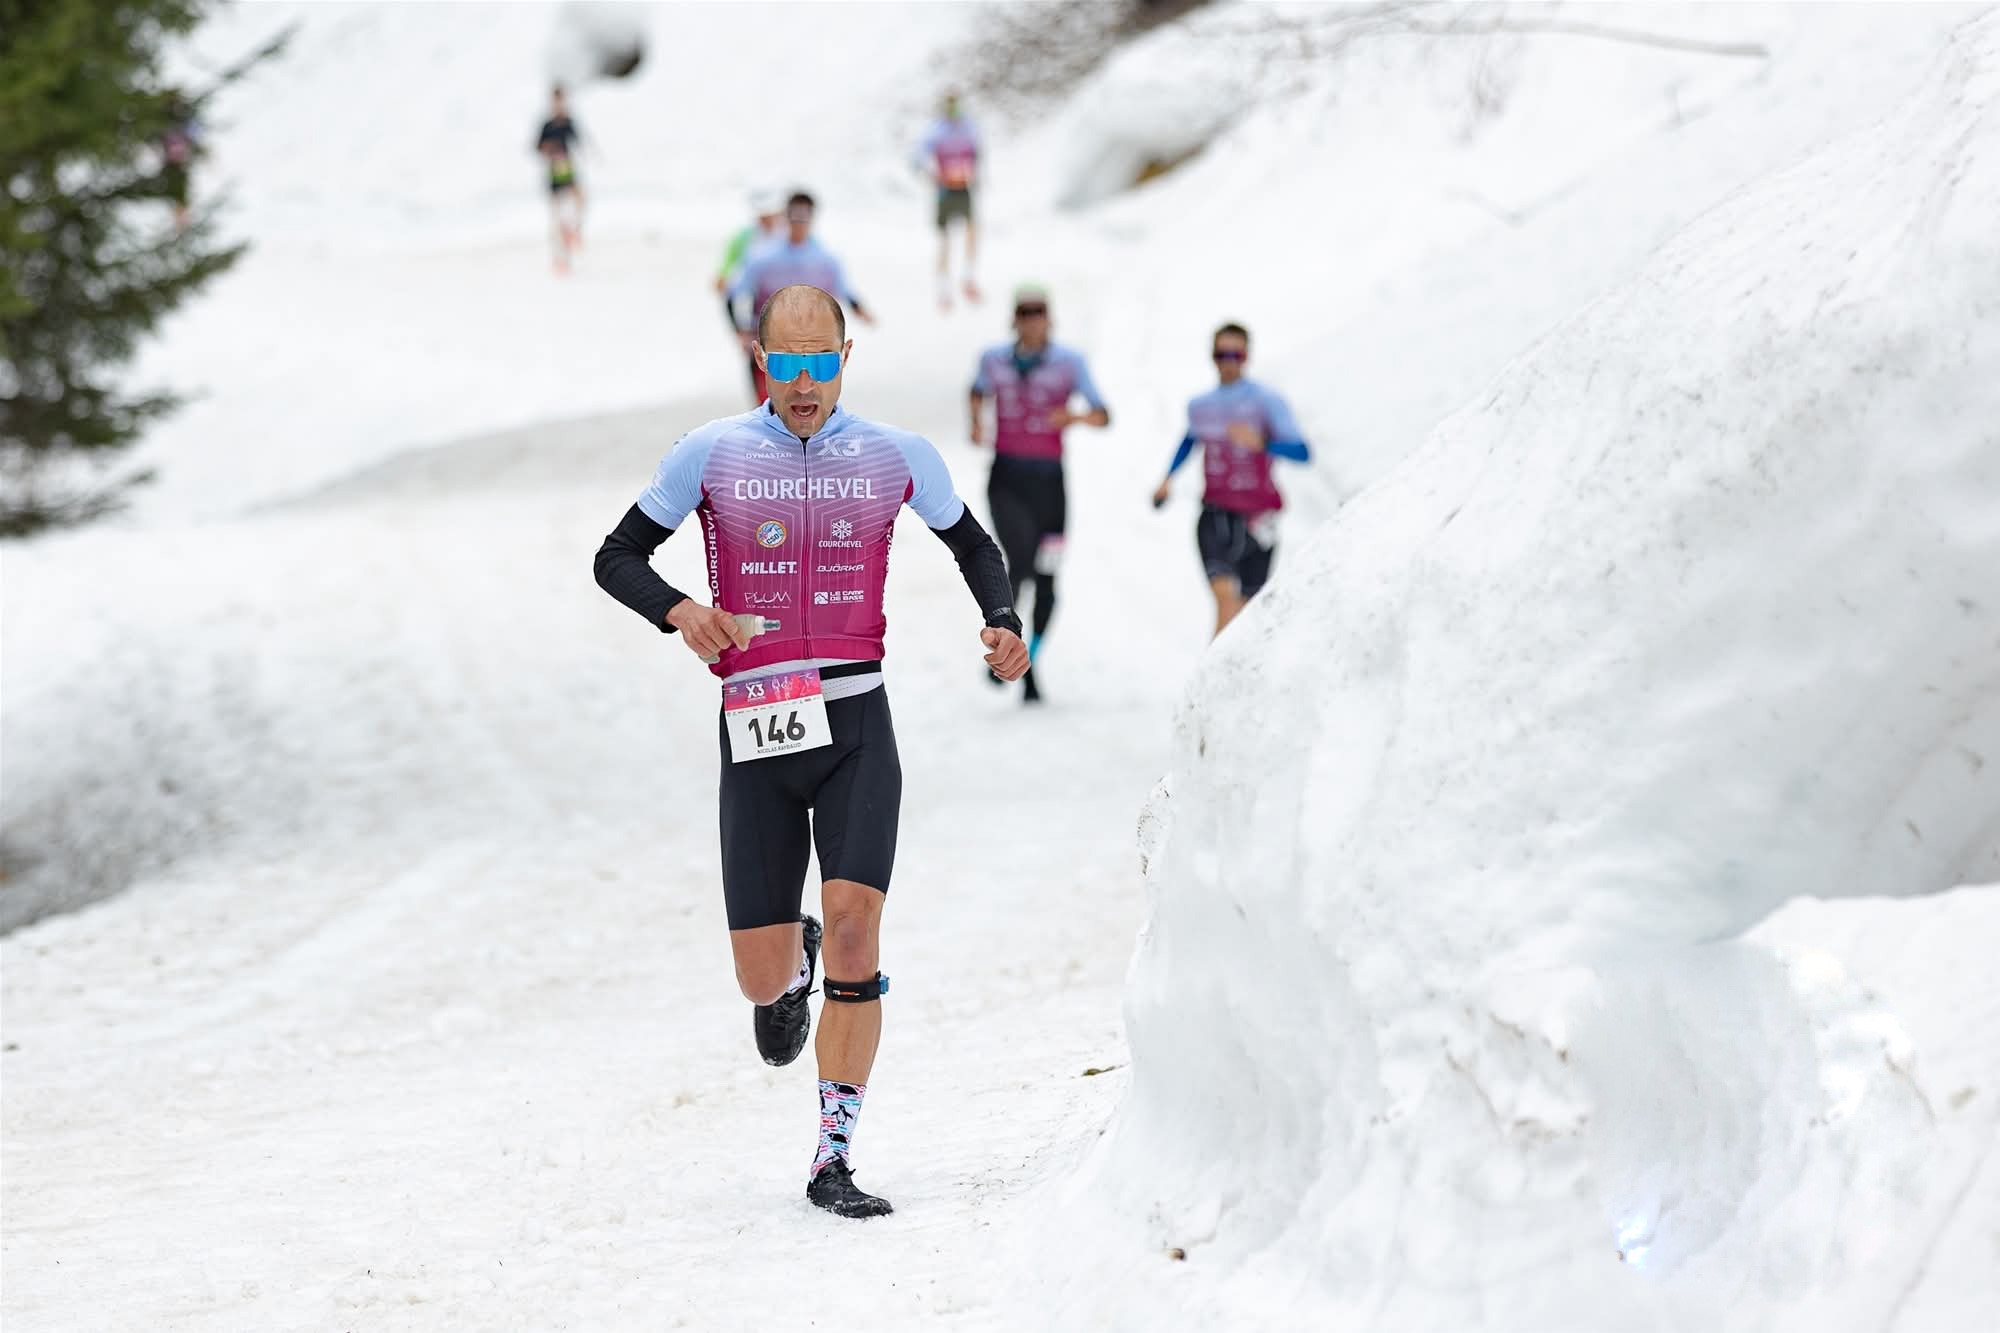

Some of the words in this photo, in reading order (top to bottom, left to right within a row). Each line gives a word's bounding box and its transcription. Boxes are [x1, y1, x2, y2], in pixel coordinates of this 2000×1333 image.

[817, 438, 864, 457] X3
[734, 478, 877, 500] COURCHEVEL
[818, 540, 863, 548] COURCHEVEL
[746, 683, 765, 699] X3
[748, 711, 806, 747] 146
